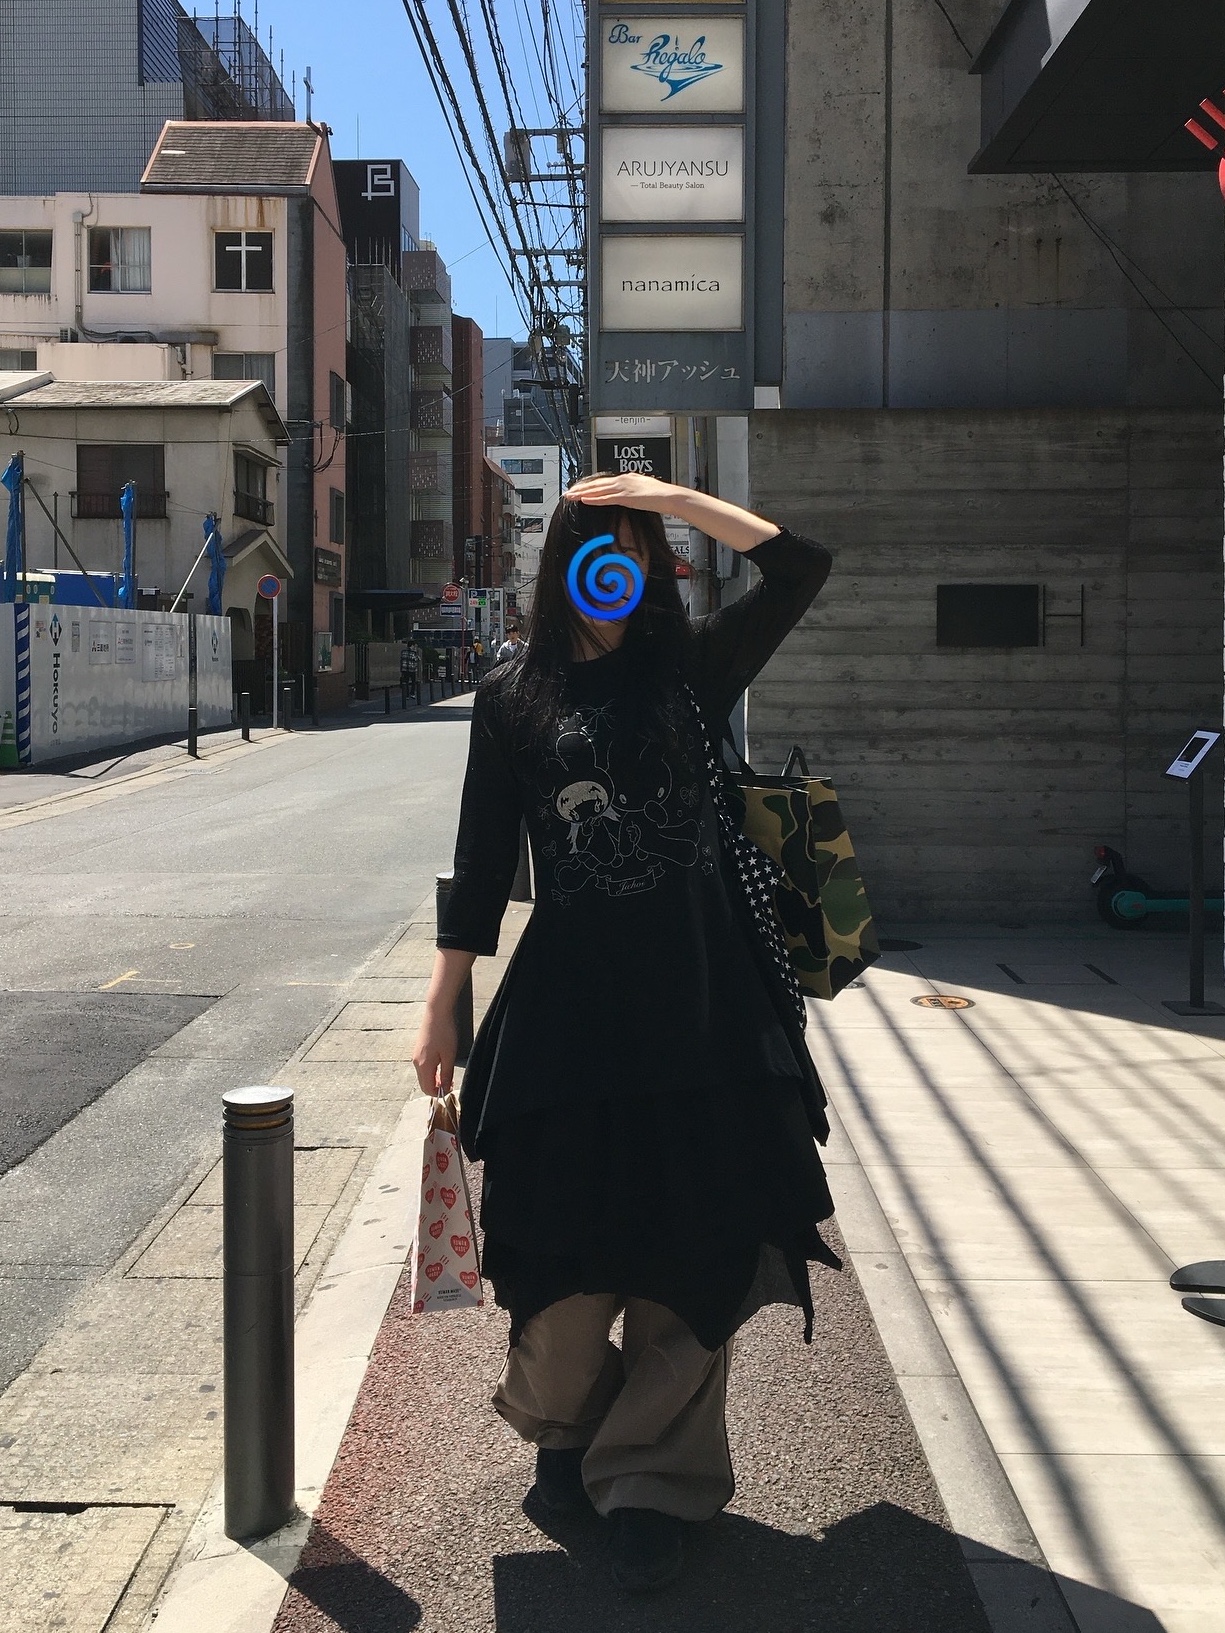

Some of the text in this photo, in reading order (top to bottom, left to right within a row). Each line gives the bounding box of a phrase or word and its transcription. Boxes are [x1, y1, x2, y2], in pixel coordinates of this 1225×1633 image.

[608, 24, 643, 44] Bar
[638, 34, 708, 83] Regalo
[616, 160, 729, 177] ARUJYANSU
[640, 181, 705, 191] Total Beauty Salon
[605, 359, 741, 383] 天神アッシュ
[51, 652, 61, 734] HOKUYO
